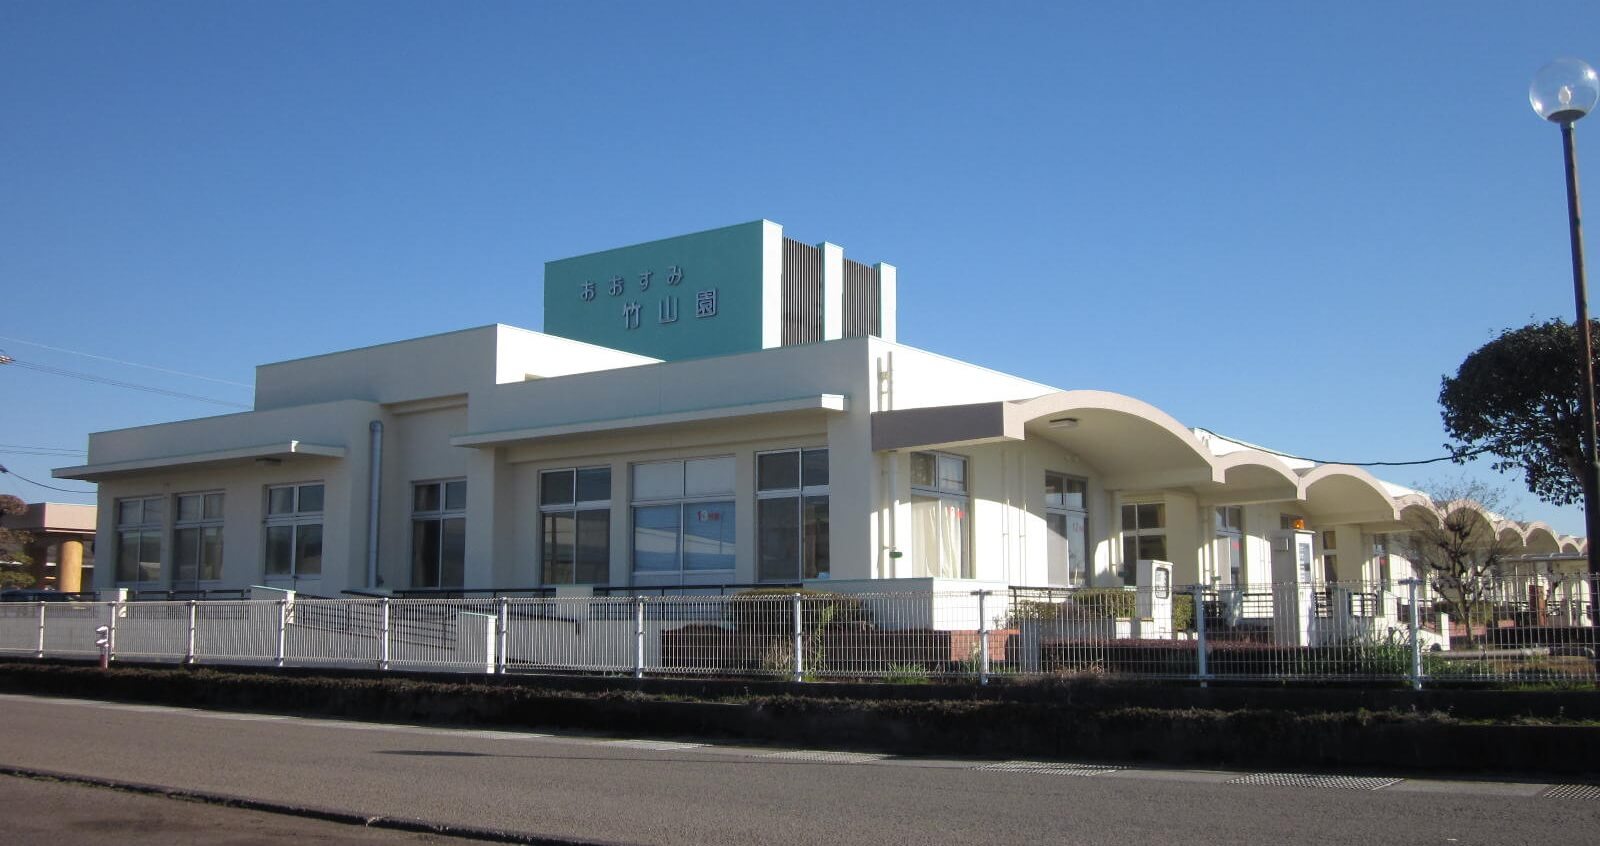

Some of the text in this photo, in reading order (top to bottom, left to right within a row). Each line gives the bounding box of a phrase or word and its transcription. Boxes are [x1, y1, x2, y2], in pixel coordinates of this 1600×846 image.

[580, 265, 684, 302] おおすみ
[623, 288, 718, 330] 竹山園
